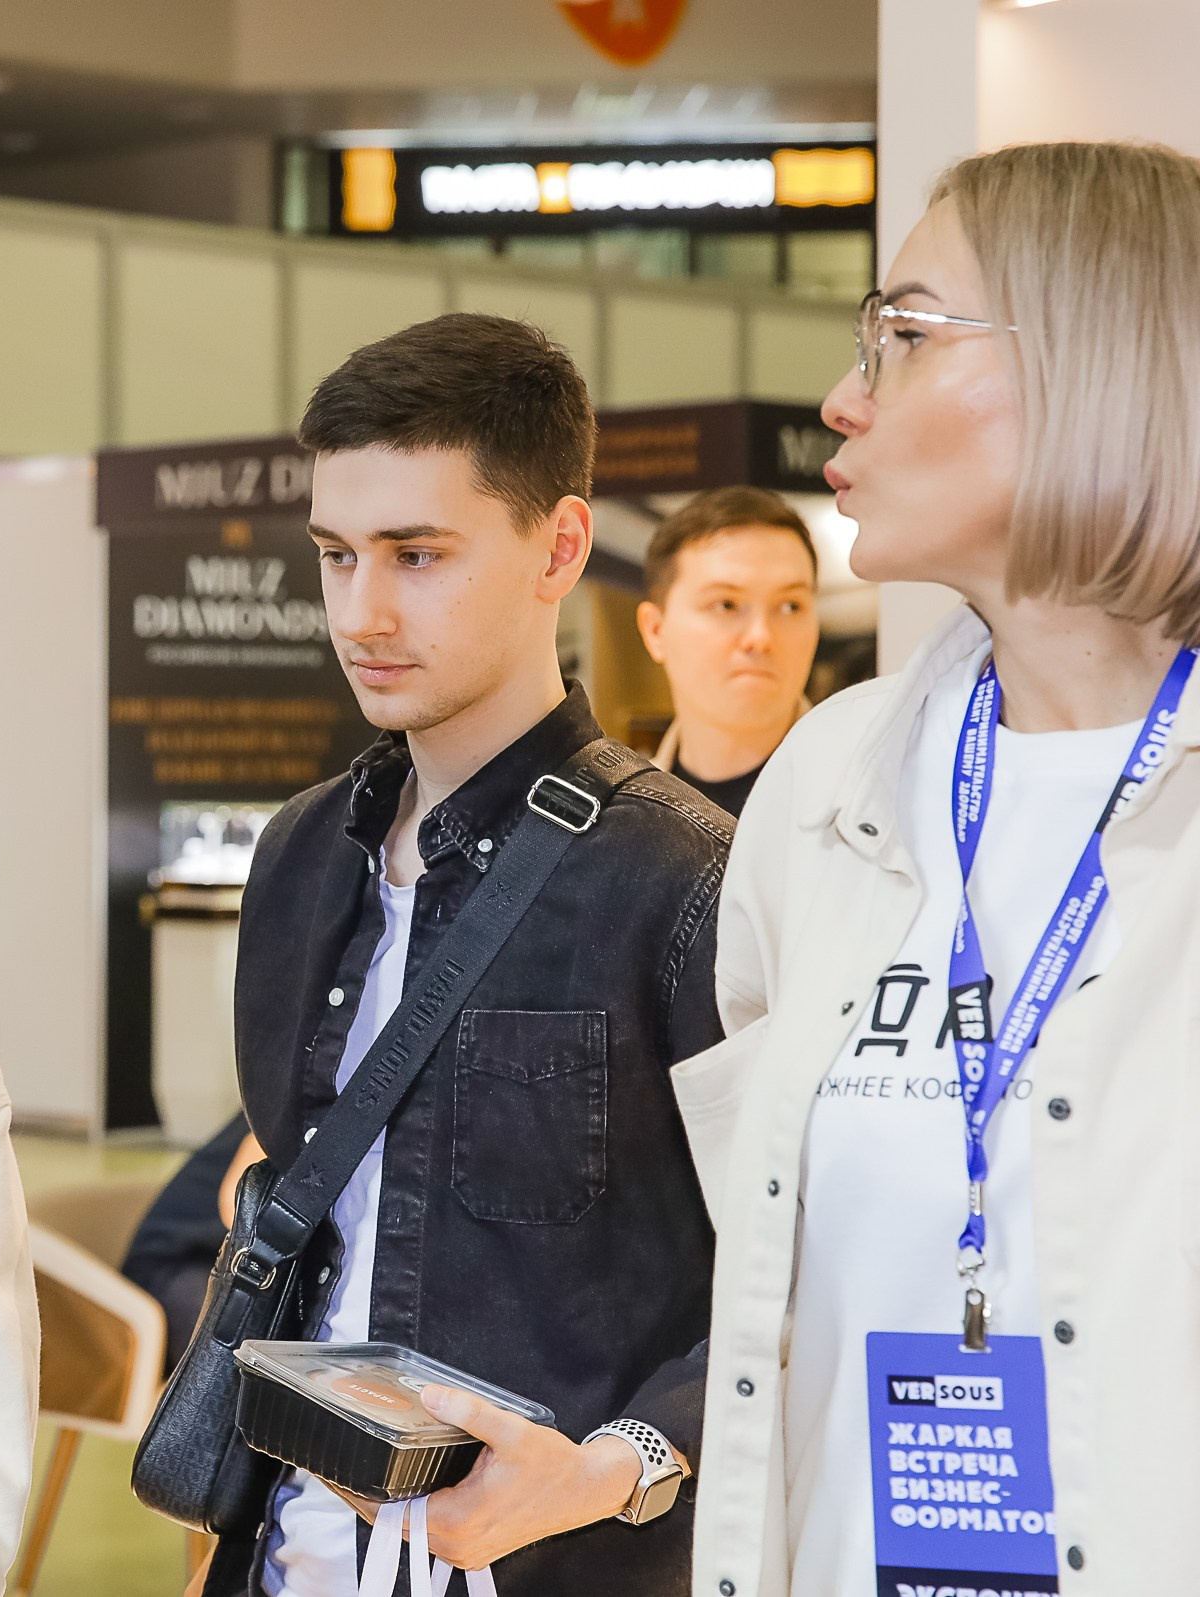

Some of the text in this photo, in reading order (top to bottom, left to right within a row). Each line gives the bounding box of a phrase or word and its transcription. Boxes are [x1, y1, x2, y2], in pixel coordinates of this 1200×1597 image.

[999, 897, 1081, 1051] ПРЕДПРИНИМАТЕЛЬСТВО
[1036, 947, 1070, 1001] ВАШЕМУ
[1065, 876, 1106, 944] ЗДОРОВЬЮ
[355, 1034, 411, 1110] JONES
[956, 987, 987, 1111] VERSOU
[887, 1422, 1013, 1449] ЖАРКАЯ
[888, 1450, 1018, 1477] ВСТРЕЧА
[889, 1477, 1011, 1504] БИЗНЕС-
